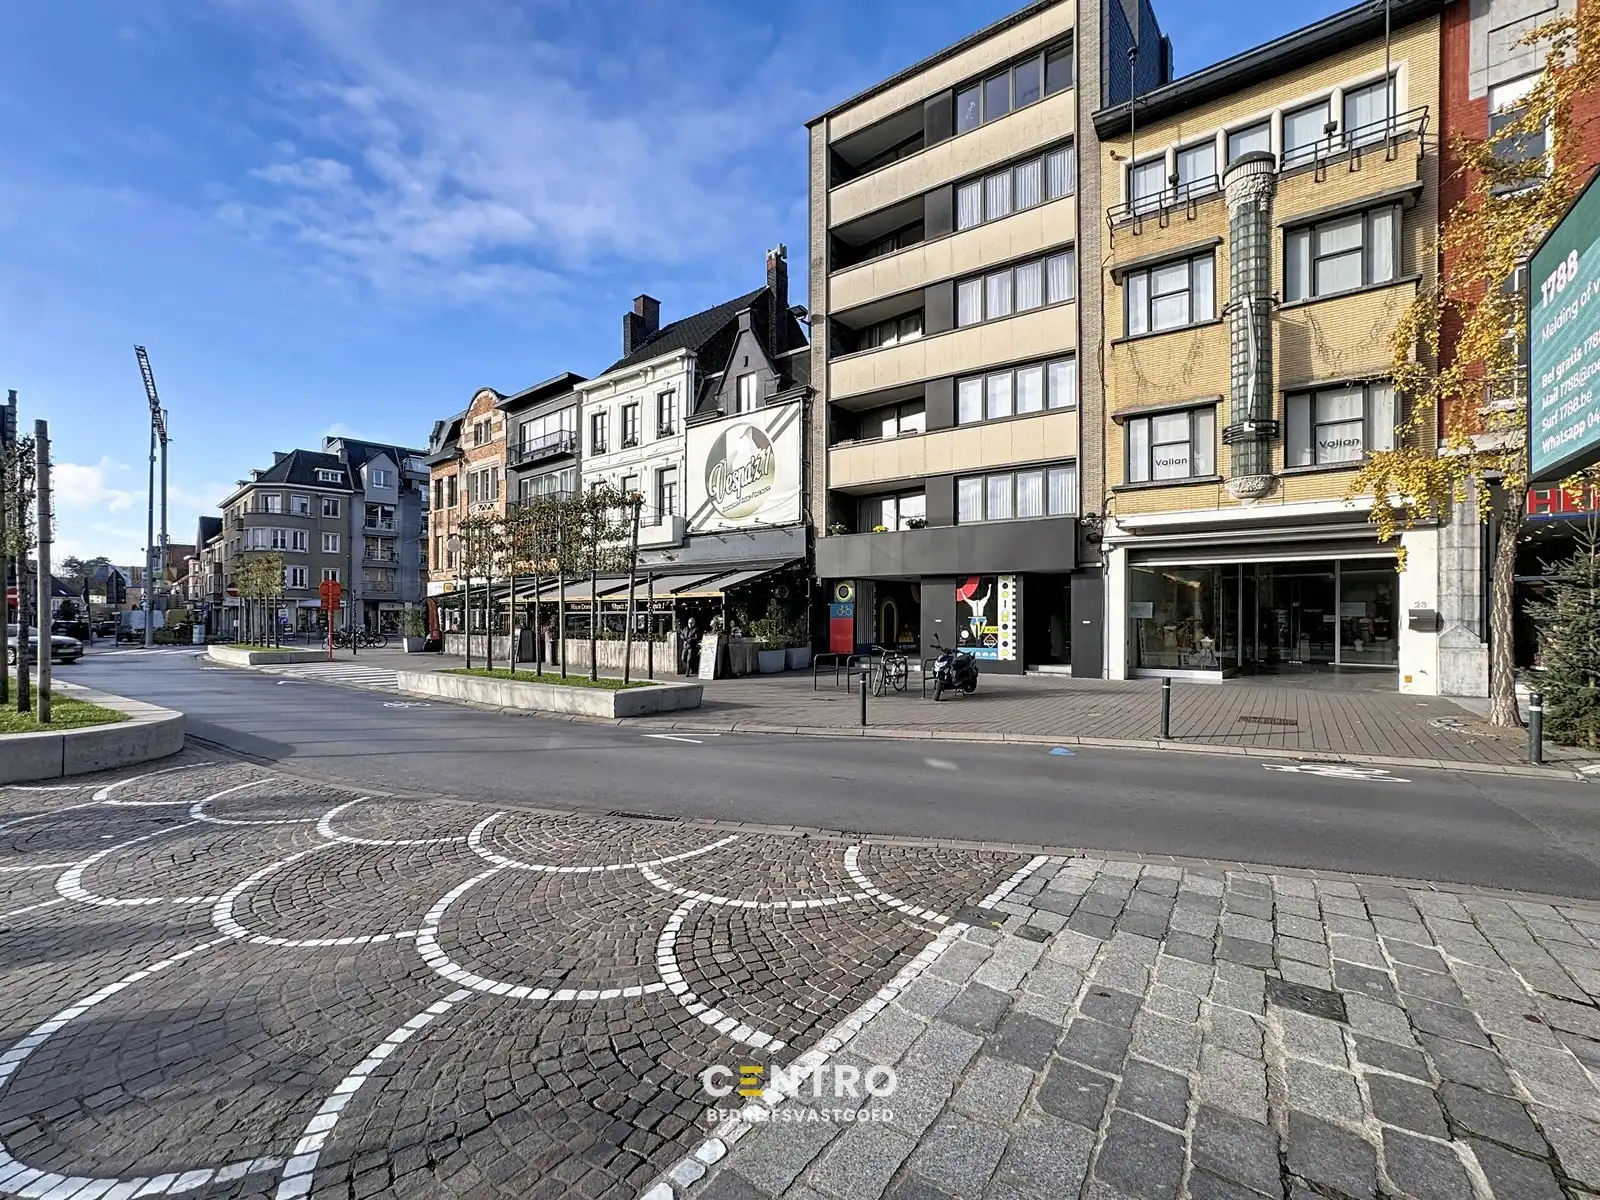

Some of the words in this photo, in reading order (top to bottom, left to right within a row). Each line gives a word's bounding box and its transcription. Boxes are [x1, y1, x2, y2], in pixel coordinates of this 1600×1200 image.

[1541, 249, 1578, 309] 1788
[1541, 299, 1579, 344] Melding
[1580, 280, 1592, 307] of
[1541, 366, 1555, 389] Bel
[1556, 347, 1582, 381] gratis
[1541, 386, 1559, 411] Mail
[1541, 409, 1559, 433] Surf
[1559, 390, 1593, 420] 1788.be
[1541, 420, 1586, 454] Whatsapp
[1413, 601, 1428, 609] 23
